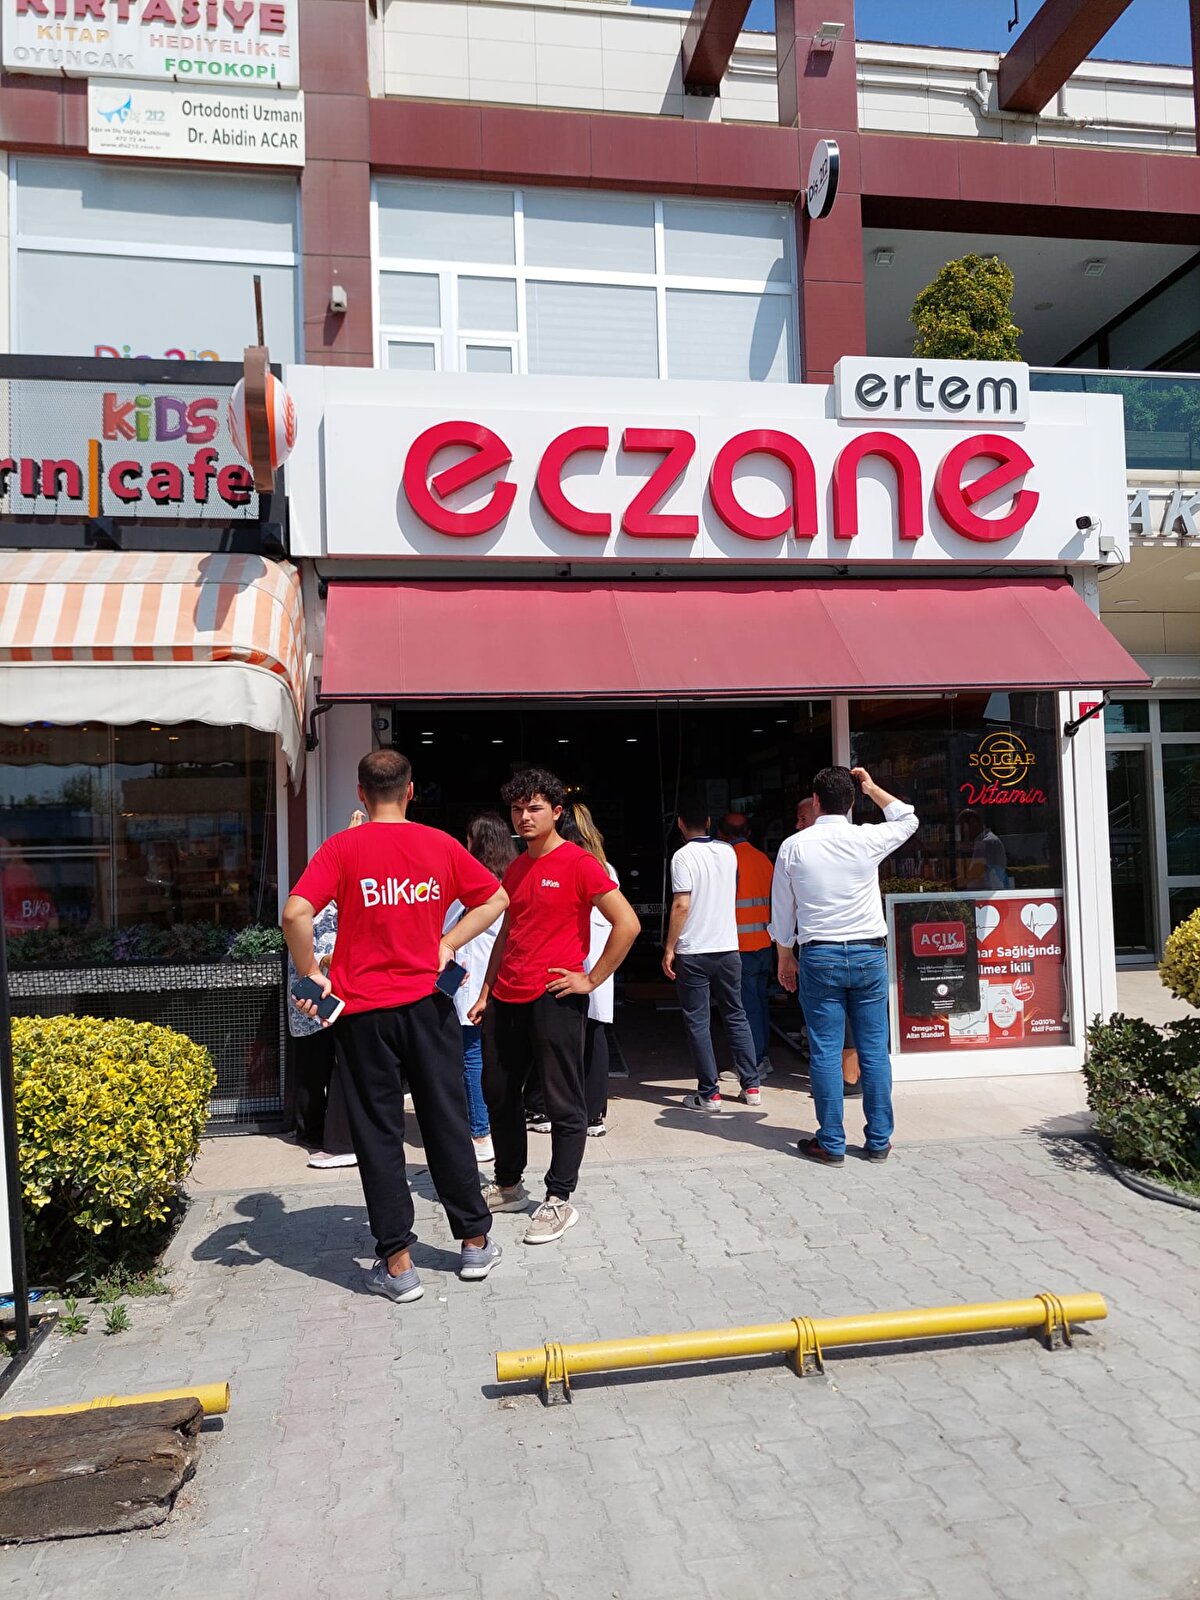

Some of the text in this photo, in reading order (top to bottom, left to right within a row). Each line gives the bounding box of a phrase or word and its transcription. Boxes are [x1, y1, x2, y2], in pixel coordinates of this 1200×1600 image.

[37, 23, 110, 43] KİTAP
[13, 46, 135, 69] OYUNCAK
[165, 58, 276, 79] FOTOKOPİ
[182, 100, 302, 123] Ortodonti Uzmanı
[188, 127, 298, 149] Dr. Abidin ACAR
[855, 367, 1018, 411] ertem
[108, 447, 254, 506] cafe
[403, 420, 1040, 543] eczane
[968, 753, 1036, 767] SOLGAR
[960, 780, 1047, 805] Vitamin
[360, 876, 440, 907] BilKid's
[920, 932, 958, 947] AÇIK
[997, 944, 1062, 958] Sağlığında
[1010, 961, 1031, 973] İkili
